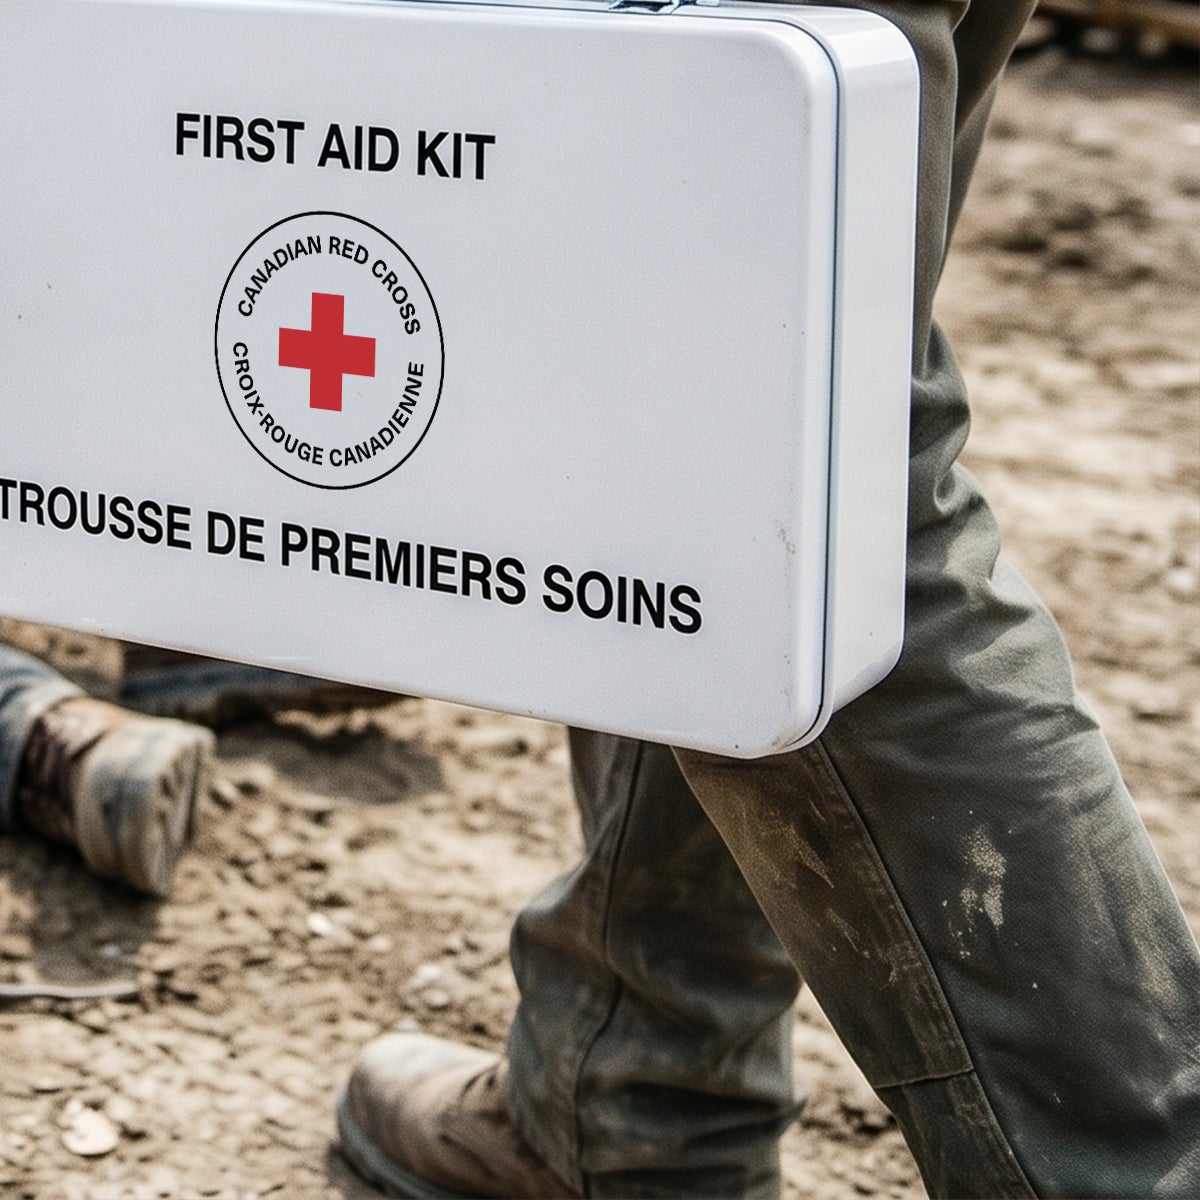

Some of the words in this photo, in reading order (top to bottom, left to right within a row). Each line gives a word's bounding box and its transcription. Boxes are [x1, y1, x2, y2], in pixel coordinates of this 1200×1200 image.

[176, 112, 305, 165] FIRST
[317, 123, 400, 172] AID
[417, 130, 496, 181] KIT
[238, 235, 322, 317] CANADIAN
[328, 235, 369, 265] RED
[371, 259, 421, 335] CROSS
[232, 341, 324, 466] CROIX-ROUGE
[329, 361, 425, 467] CANADIENNE
[207, 510, 265, 563] DE
[281, 522, 526, 605] PREMIERS
[542, 564, 702, 635] SOINS
